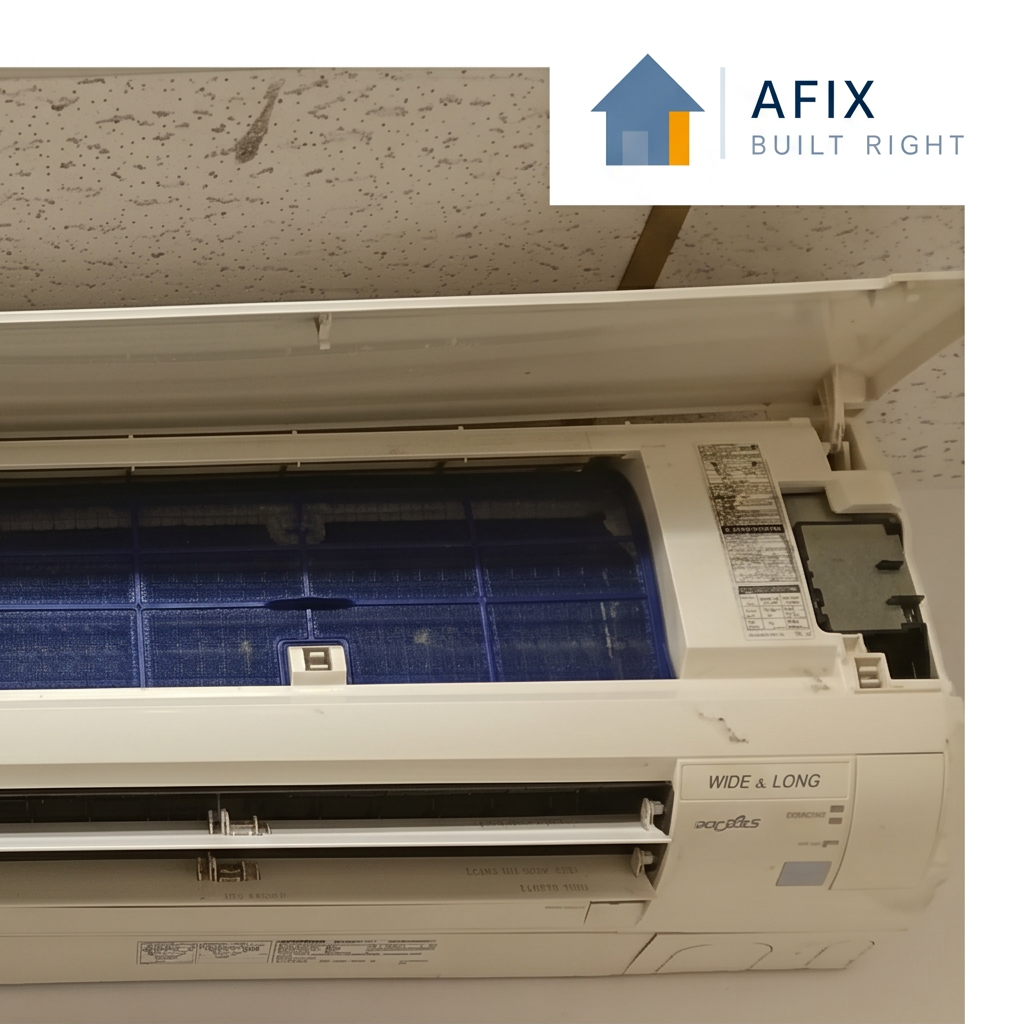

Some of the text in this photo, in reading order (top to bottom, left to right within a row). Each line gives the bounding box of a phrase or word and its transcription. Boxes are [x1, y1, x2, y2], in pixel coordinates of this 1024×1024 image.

[708, 773, 821, 789] WIDE & LONG
